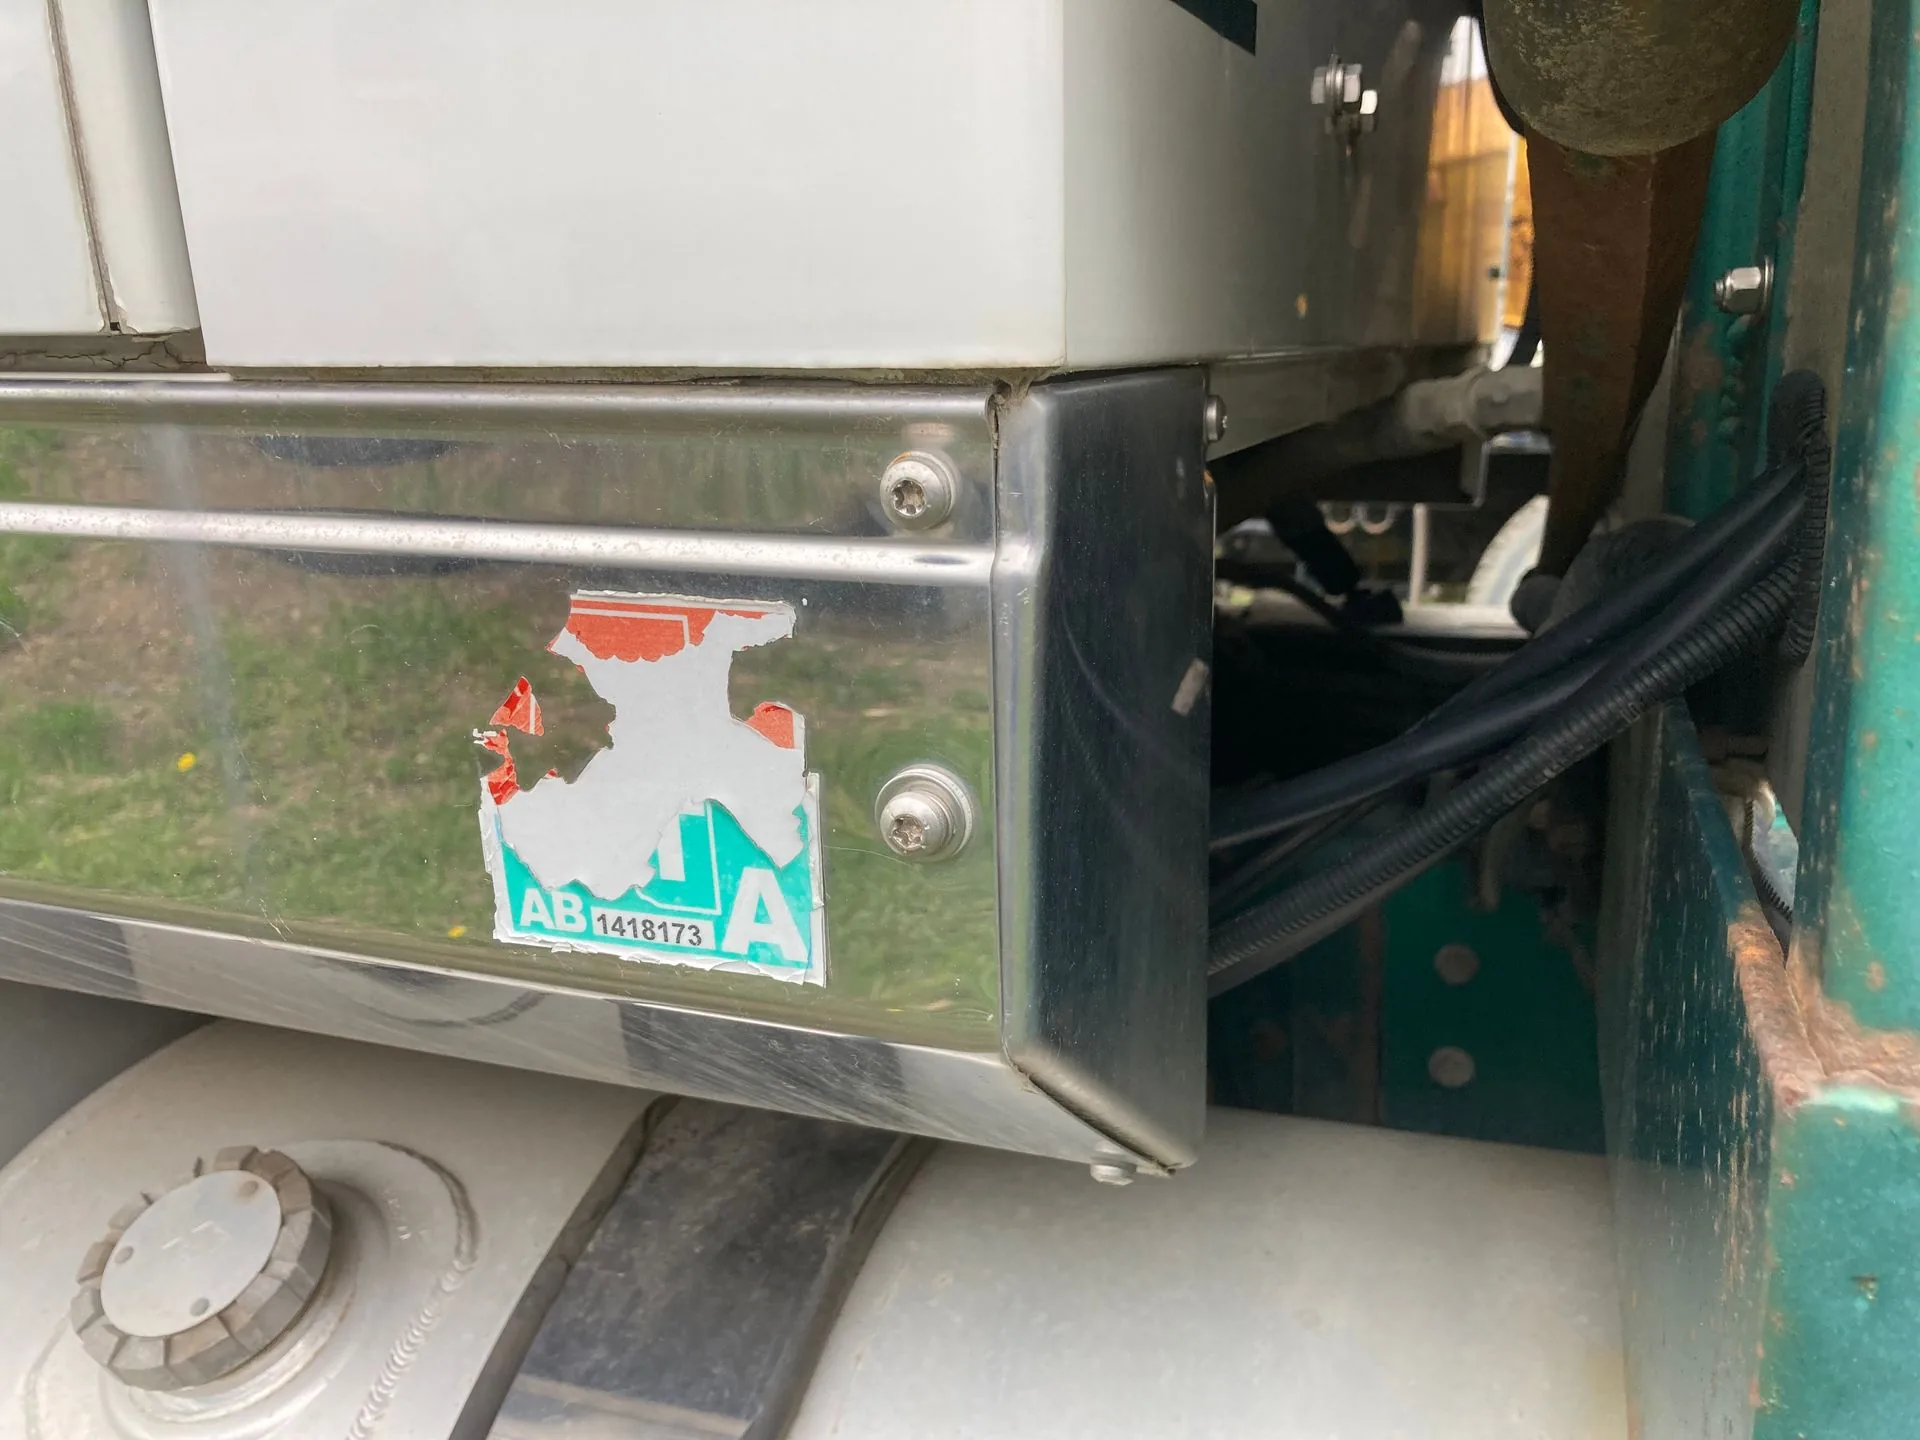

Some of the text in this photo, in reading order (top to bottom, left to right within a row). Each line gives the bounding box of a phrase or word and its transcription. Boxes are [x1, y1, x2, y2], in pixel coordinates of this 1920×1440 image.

[519, 887, 702, 946] AB 1418173
[721, 866, 808, 961] A
